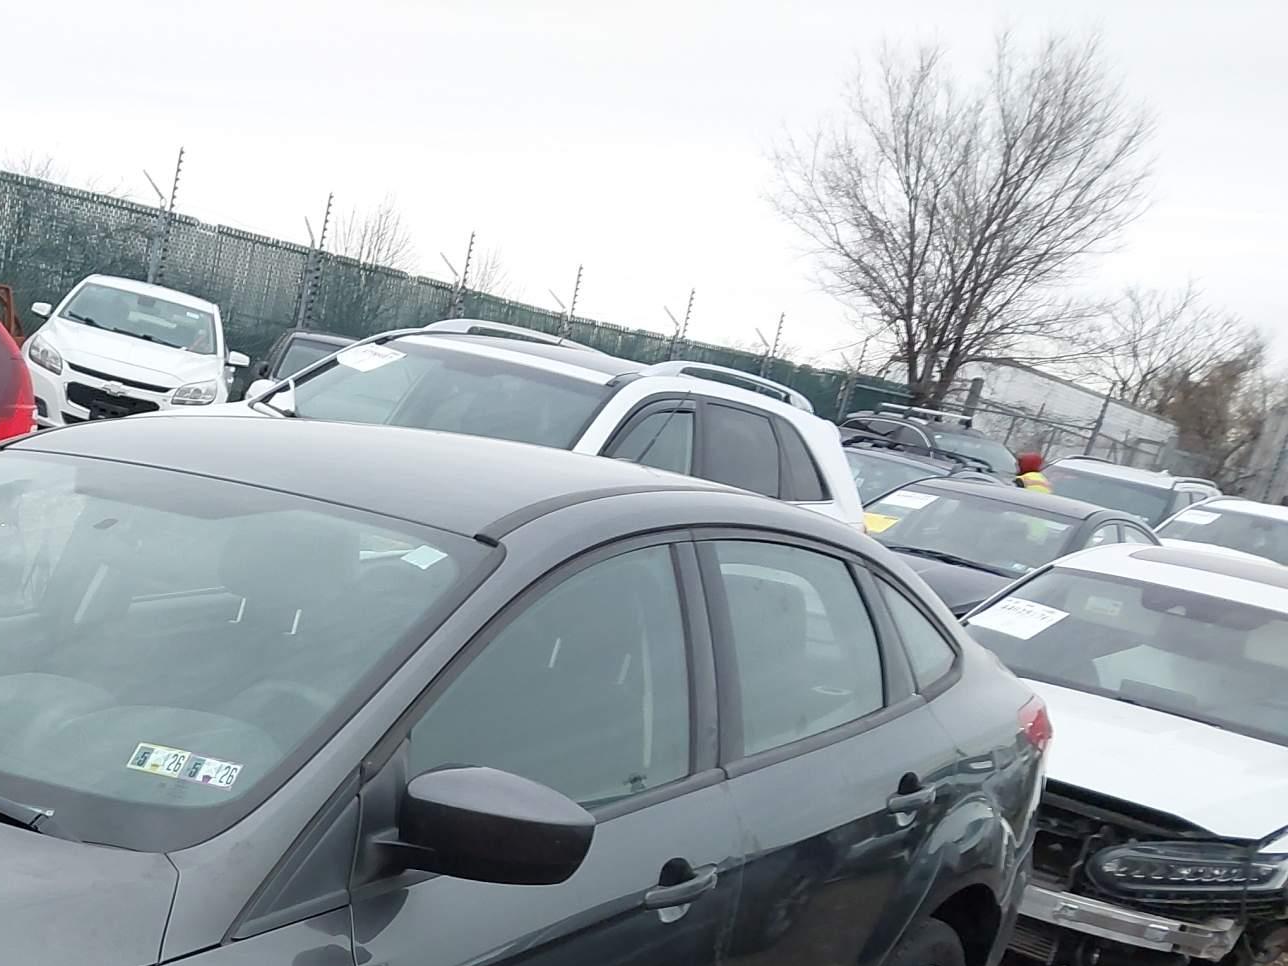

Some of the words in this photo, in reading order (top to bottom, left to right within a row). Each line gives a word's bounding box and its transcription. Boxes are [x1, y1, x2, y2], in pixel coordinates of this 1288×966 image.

[136, 751, 151, 767] 5
[166, 753, 186, 773] 26
[188, 762, 202, 778] 5
[218, 765, 238, 785] 26
